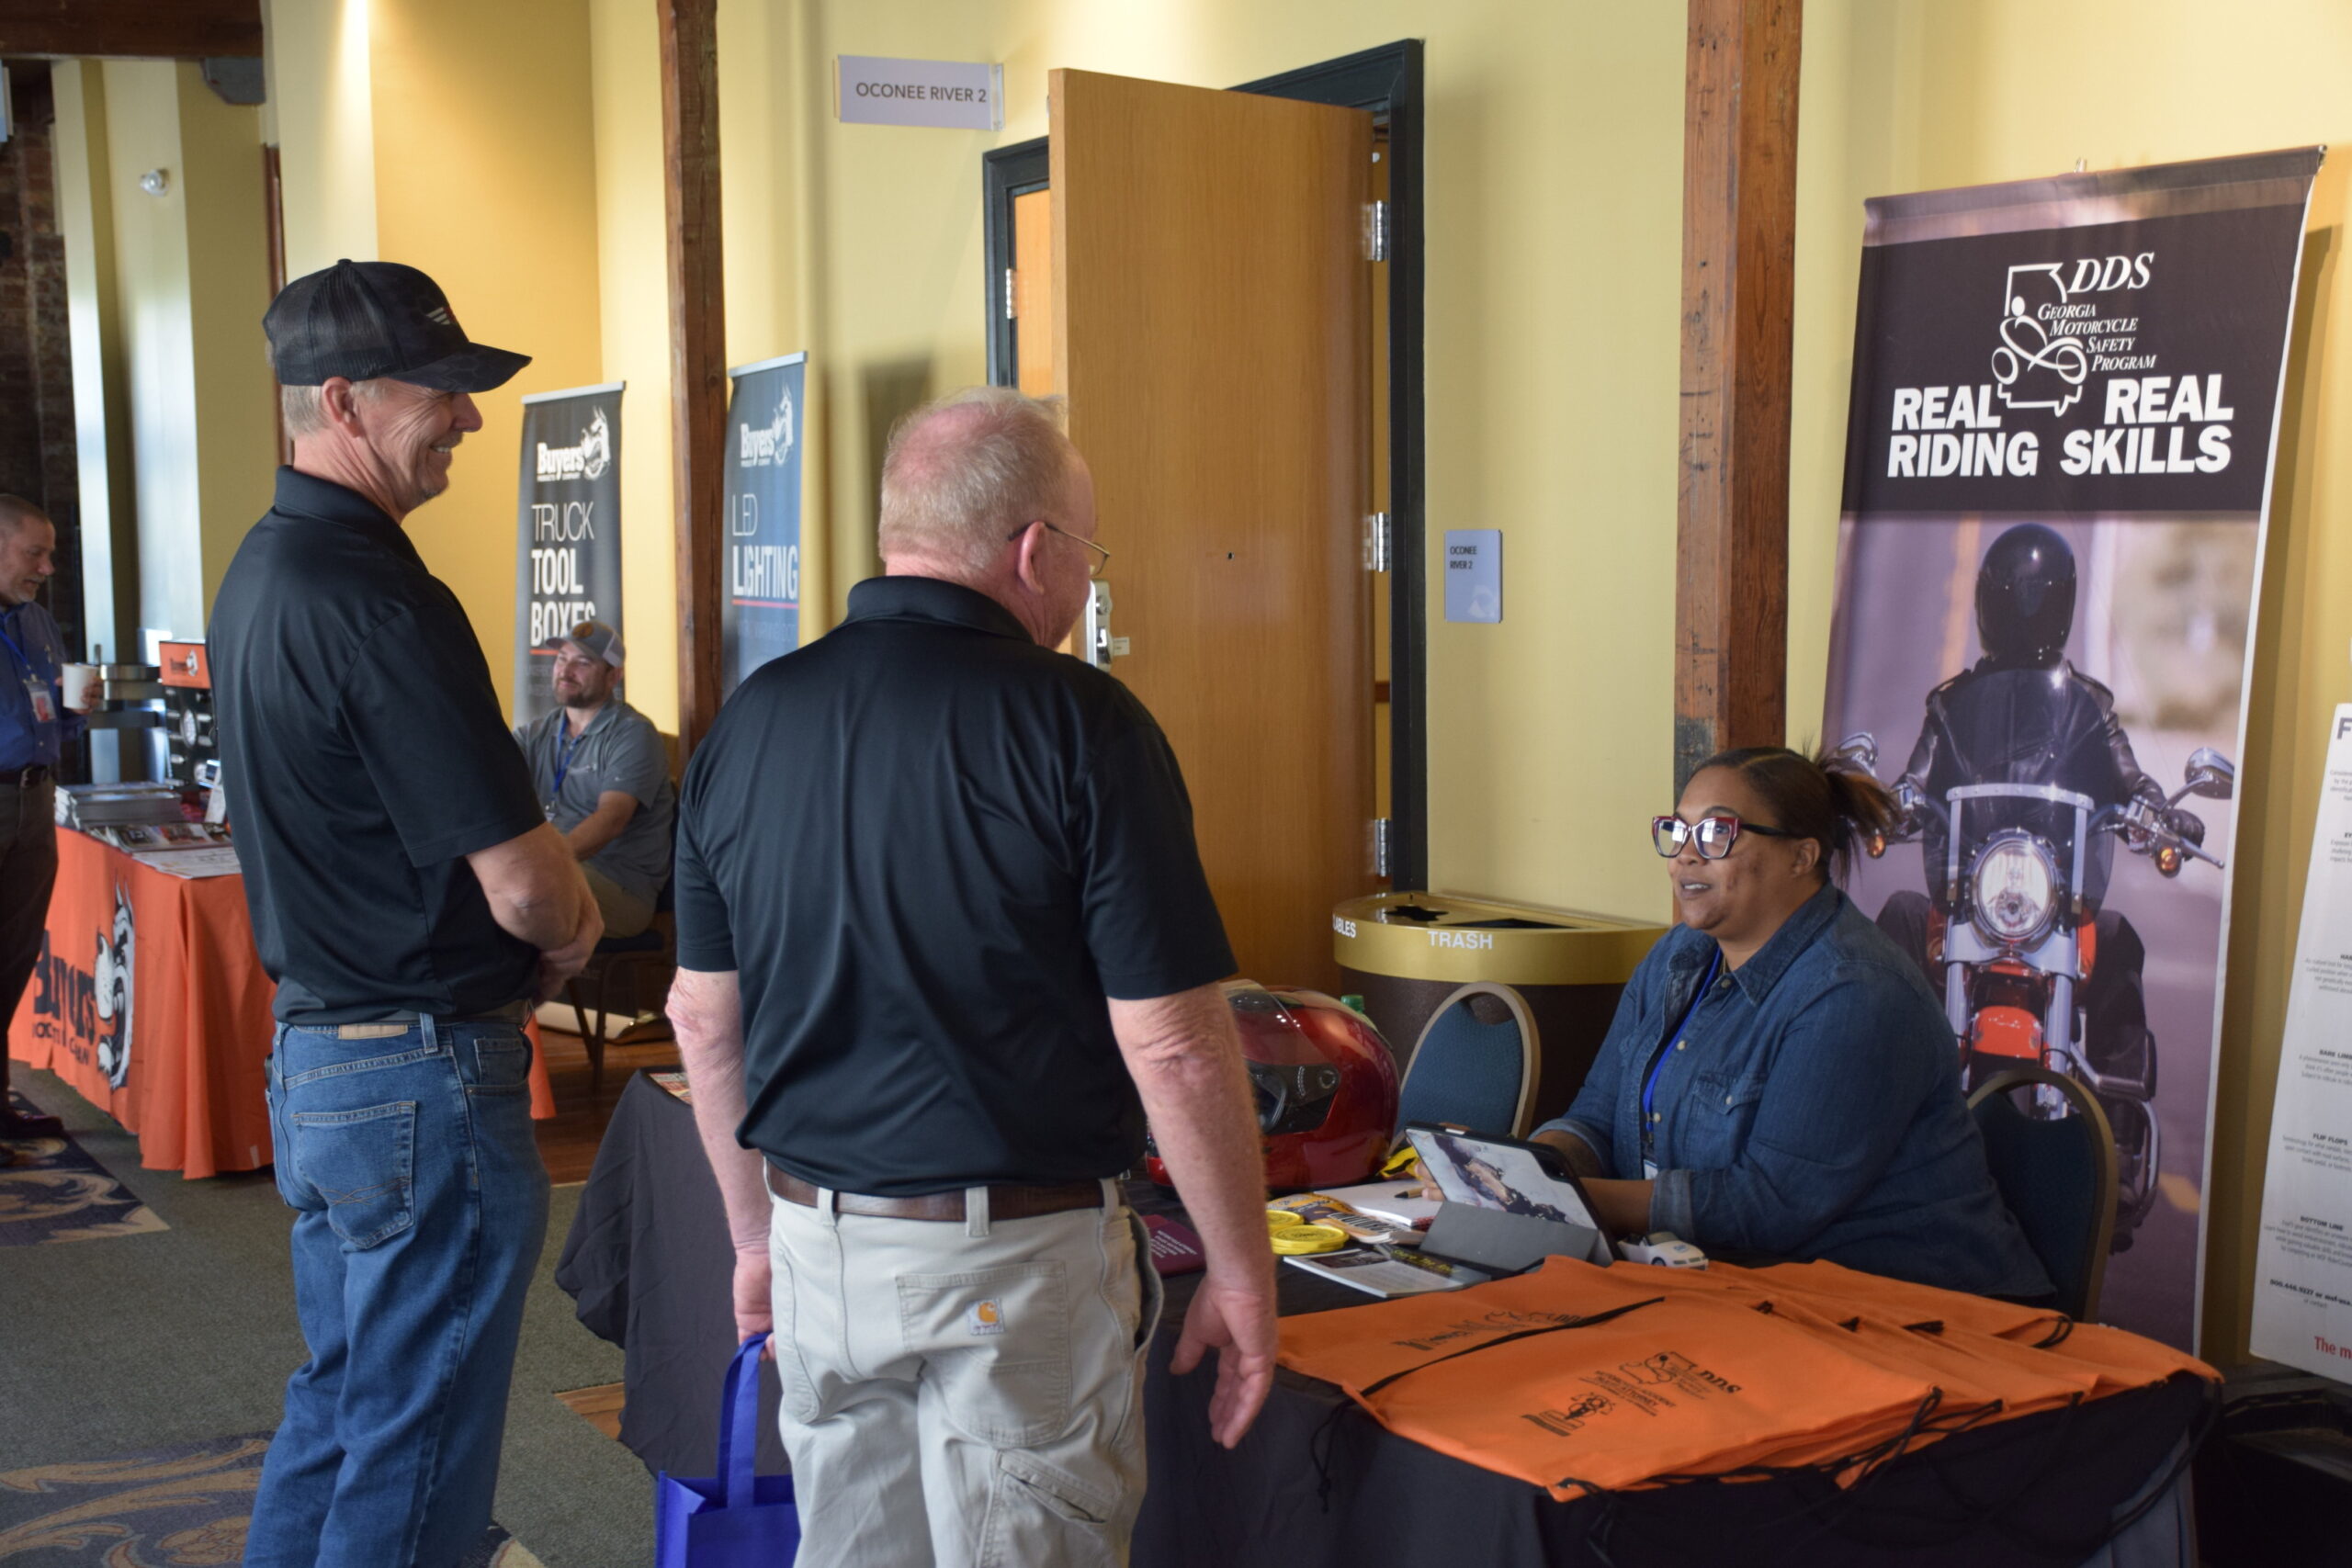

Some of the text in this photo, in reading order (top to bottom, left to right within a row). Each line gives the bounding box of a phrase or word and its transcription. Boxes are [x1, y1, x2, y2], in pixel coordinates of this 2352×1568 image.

[855, 83, 987, 103] OCONEE RIVER 2
[2067, 253, 2154, 294] DDS
[2037, 303, 2097, 321] GEORGIA
[2049, 318, 2138, 336] MOTORCYCLE
[2086, 336, 2136, 355] SAFETY
[2091, 355, 2157, 372] PROGRAM
[1891, 374, 2234, 432] REAL REAL
[740, 423, 775, 464] Buyers
[1887, 425, 2232, 479] RIDING SKILLS
[537, 442, 585, 481] Buyers
[531, 501, 595, 542] TRUCK
[732, 493, 758, 537] LED
[1450, 546, 1477, 555] OCONEE
[531, 547, 583, 595] TOOL
[732, 545, 798, 600] LIGHTING
[1450, 561, 1473, 570] RIVER 2
[1427, 931, 1493, 950] TRASH
[2312, 1133, 2348, 1146] FLIP FLOPS
[2300, 1215, 2345, 1232] BOTTOM LINE
[2314, 1336, 2336, 1356] The
